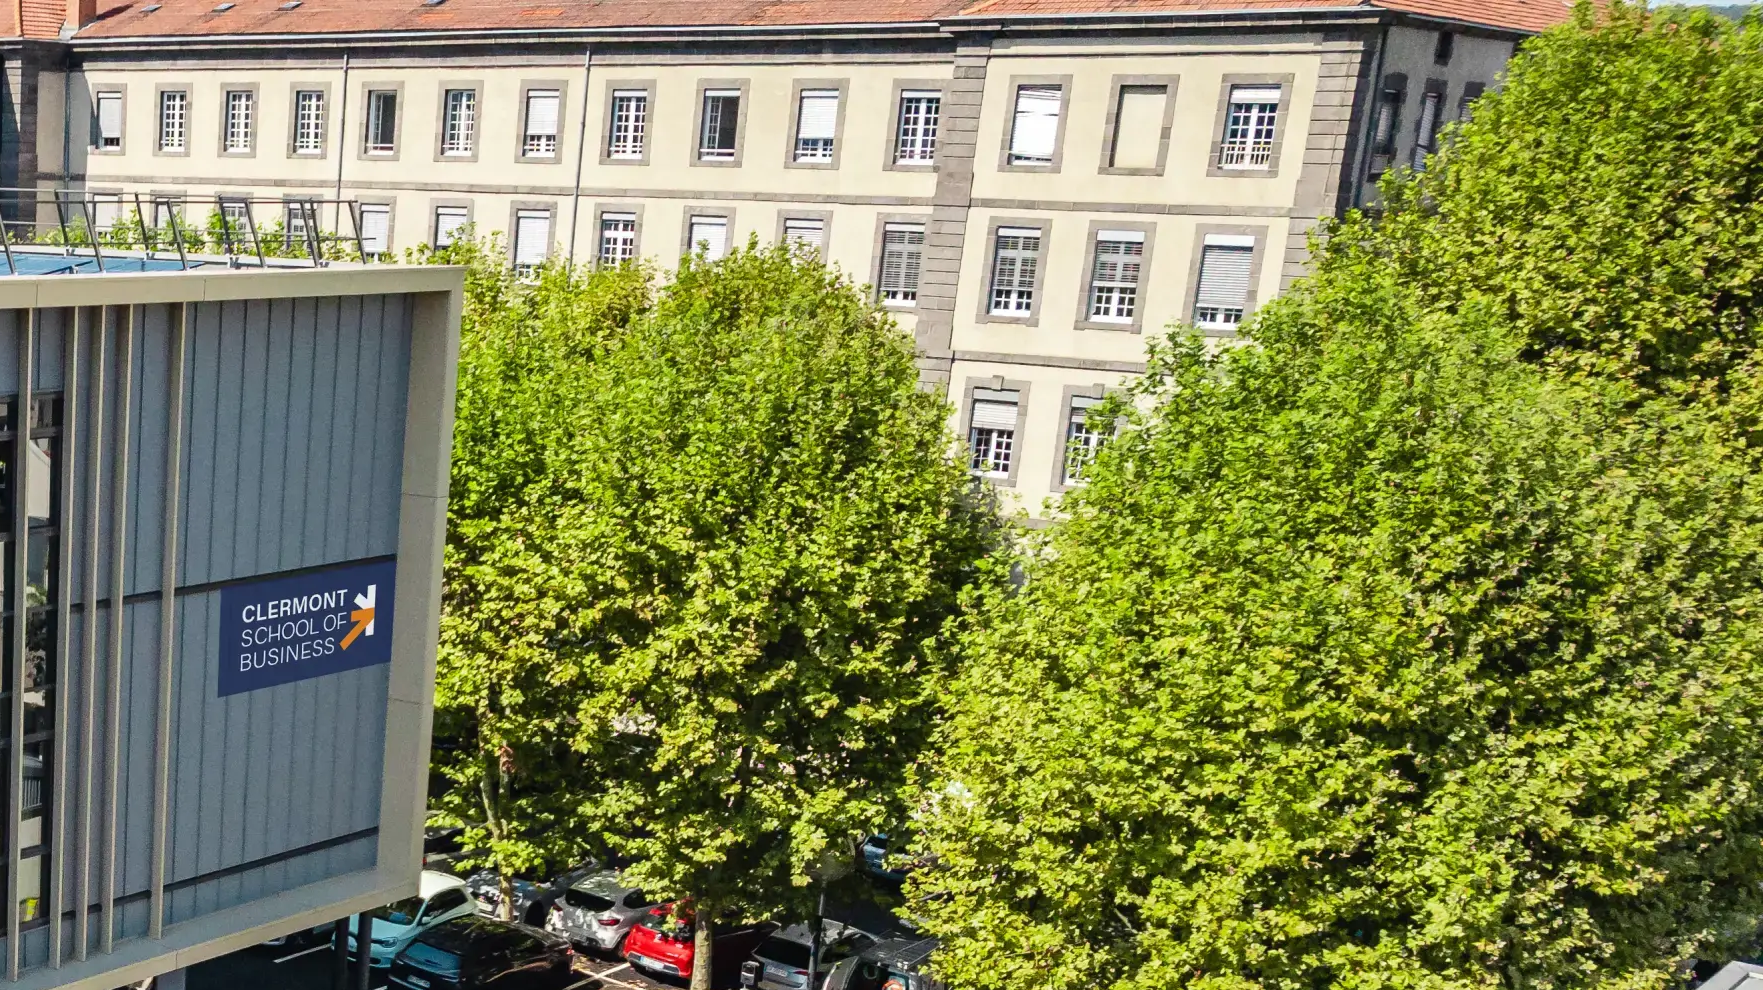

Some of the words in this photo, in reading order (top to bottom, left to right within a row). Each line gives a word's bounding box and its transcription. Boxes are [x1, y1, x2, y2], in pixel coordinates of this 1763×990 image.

[242, 589, 348, 624] CLERMONT
[241, 618, 319, 648] SCHOOL
[323, 612, 347, 632] OF
[240, 637, 335, 672] BUSINESS
